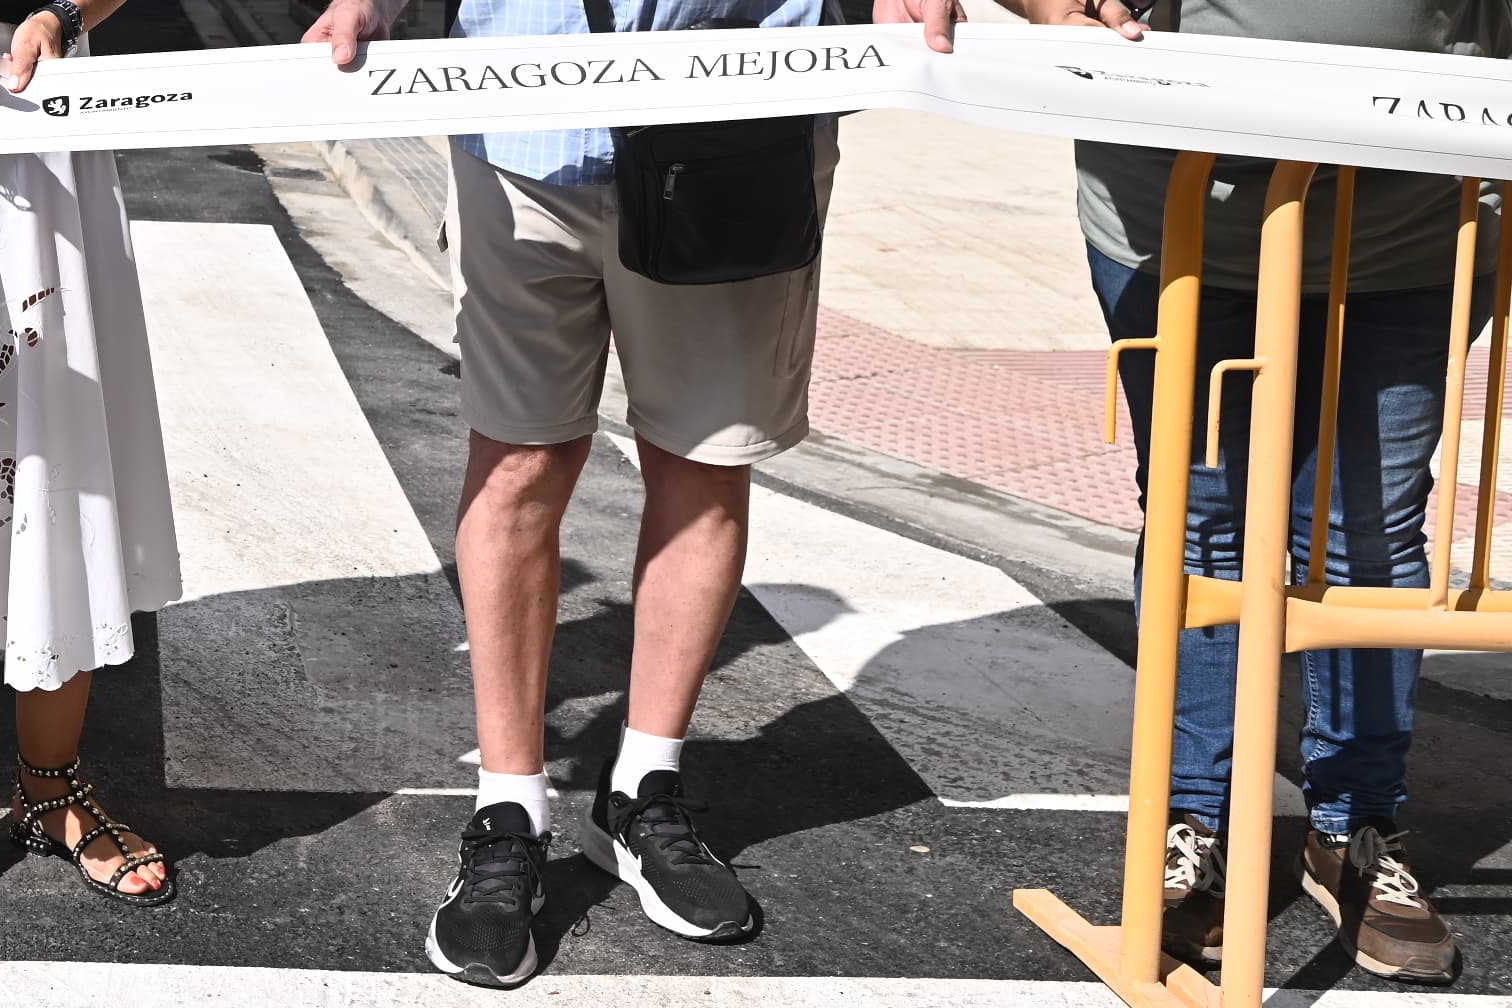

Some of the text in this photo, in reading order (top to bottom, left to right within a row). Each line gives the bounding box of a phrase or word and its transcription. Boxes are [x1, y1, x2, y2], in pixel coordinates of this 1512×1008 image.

[368, 44, 891, 96] ZARAGOZA MEJORA
[79, 92, 193, 109] Zaragoza
